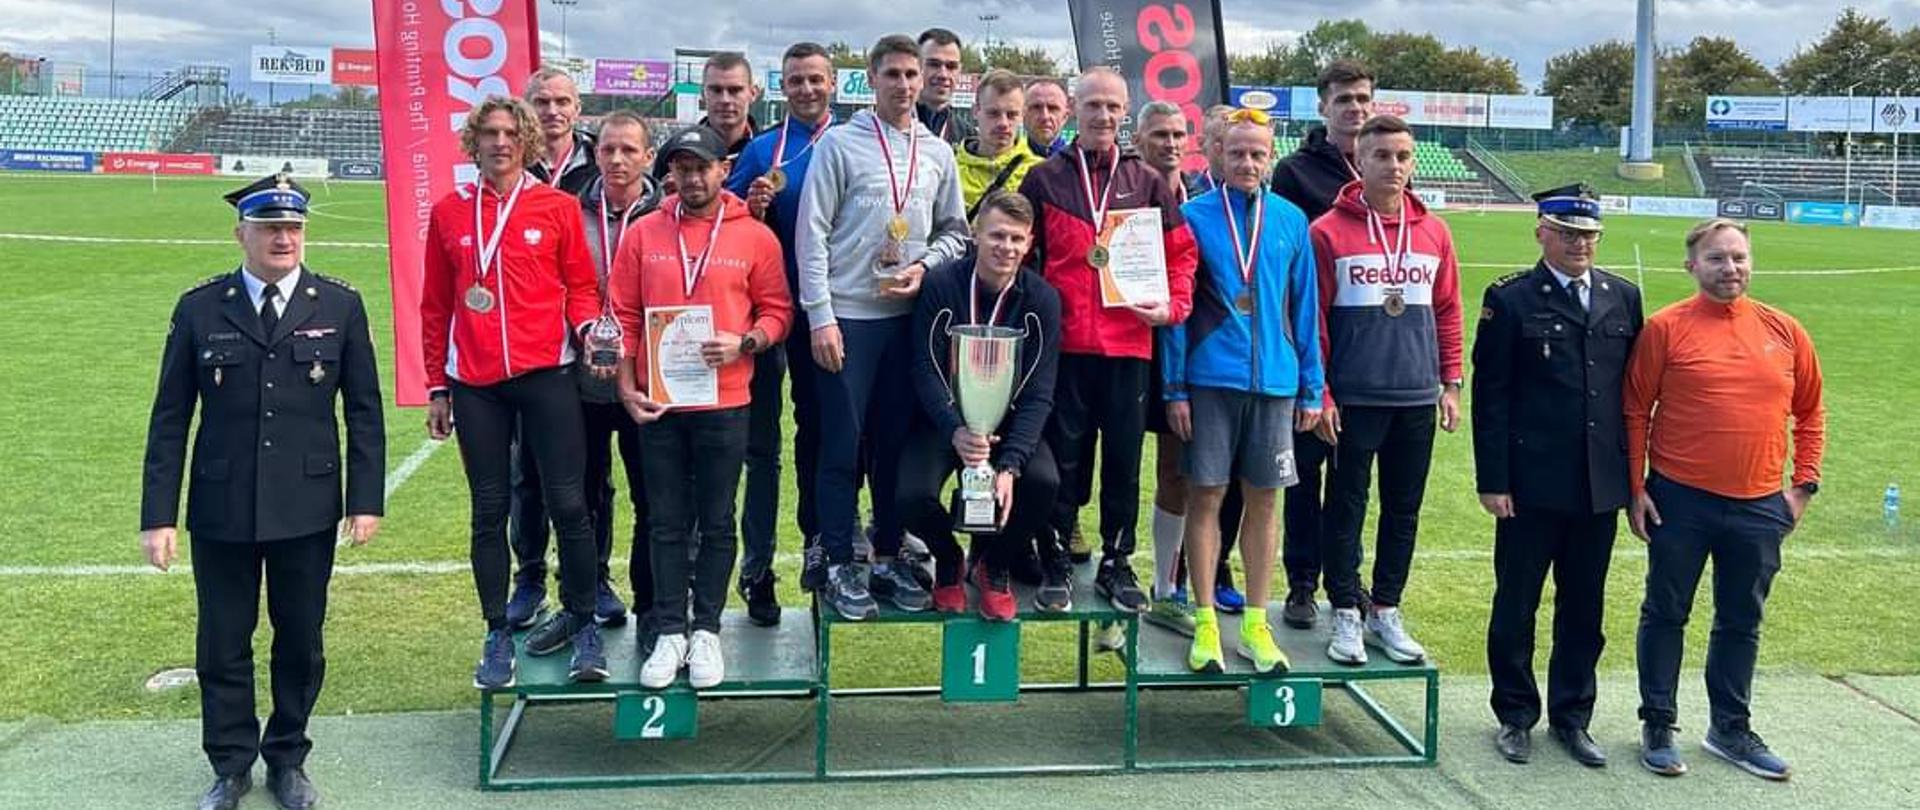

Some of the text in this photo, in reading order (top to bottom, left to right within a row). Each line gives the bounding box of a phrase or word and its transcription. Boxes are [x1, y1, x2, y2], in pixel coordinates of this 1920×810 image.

[1349, 265, 1432, 285] Reebok
[971, 643, 987, 684] 1
[641, 695, 666, 738] 2
[1273, 686, 1296, 727] 3
